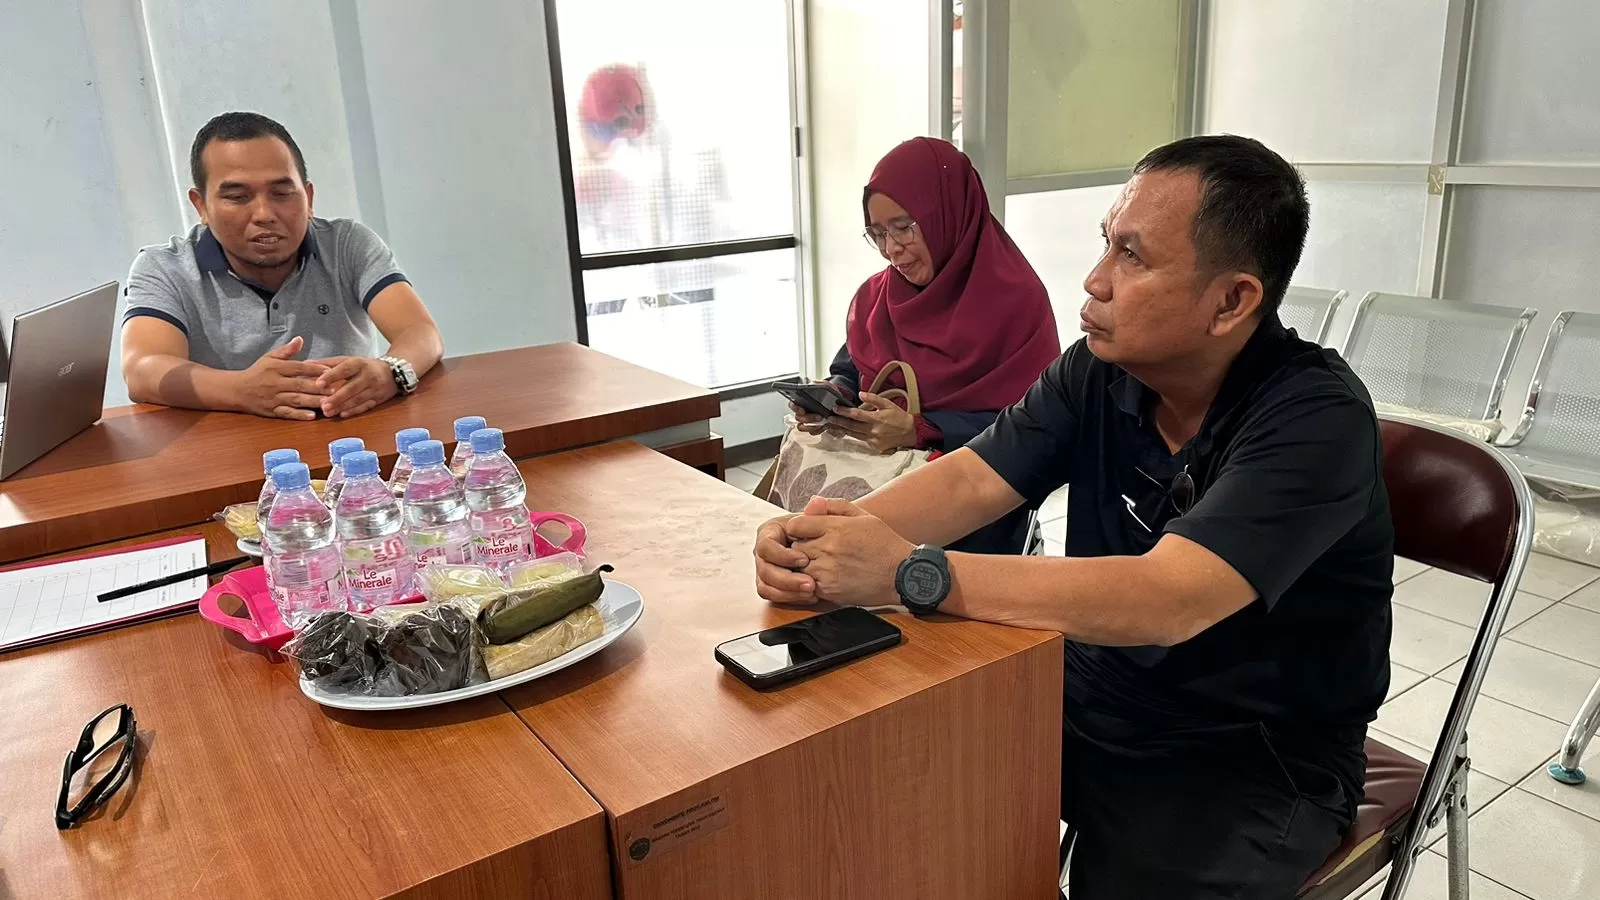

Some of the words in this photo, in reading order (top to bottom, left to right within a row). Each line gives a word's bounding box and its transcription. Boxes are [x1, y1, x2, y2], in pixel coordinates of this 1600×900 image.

[58, 362, 74, 377] acer
[492, 537, 505, 547] Le
[477, 543, 518, 555] Minerale
[416, 553, 428, 564] Le
[363, 570, 377, 580] Le
[349, 576, 392, 589] Minerale
